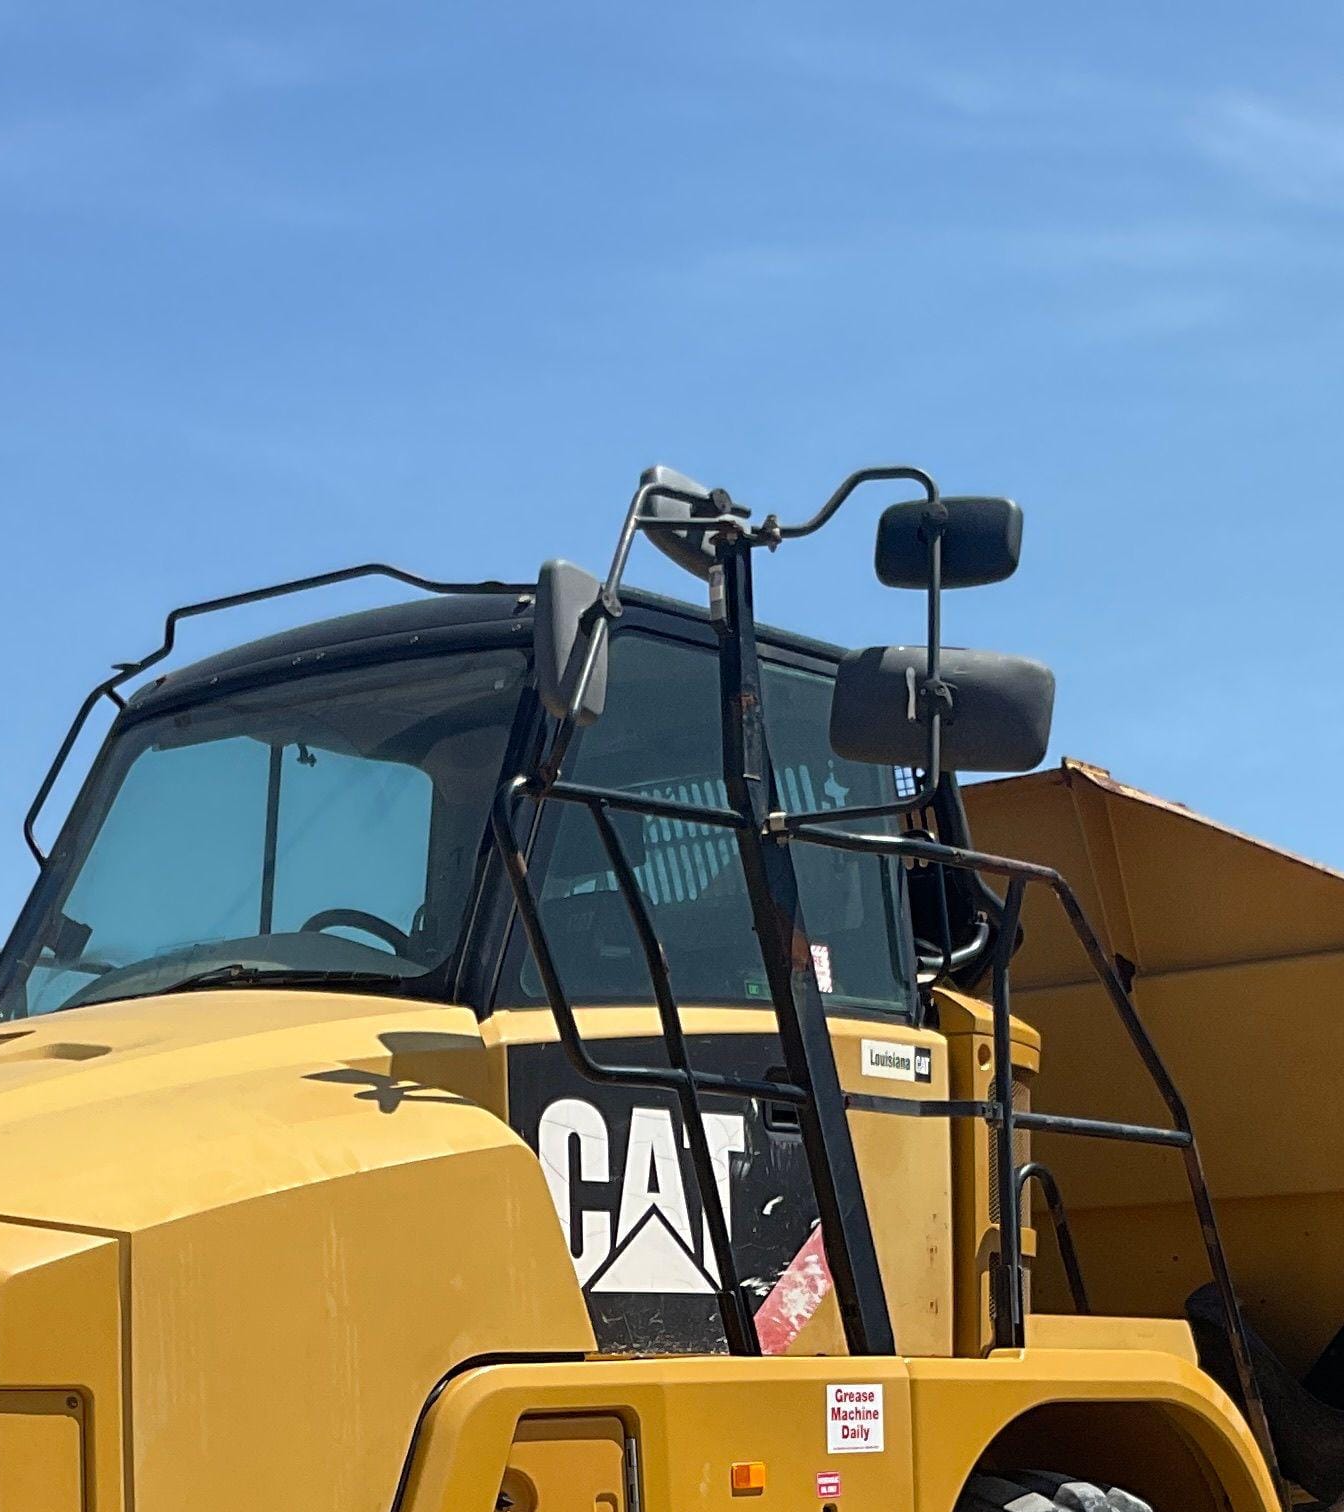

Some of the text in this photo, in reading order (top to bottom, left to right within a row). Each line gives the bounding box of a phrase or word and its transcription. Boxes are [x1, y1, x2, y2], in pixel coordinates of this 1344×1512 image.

[869, 1048, 930, 1075] Louisiana CAT
[538, 1098, 745, 1294] CAT
[835, 1388, 875, 1403] Grease
[831, 1407, 879, 1421] Machine
[841, 1425, 870, 1441] Daily
